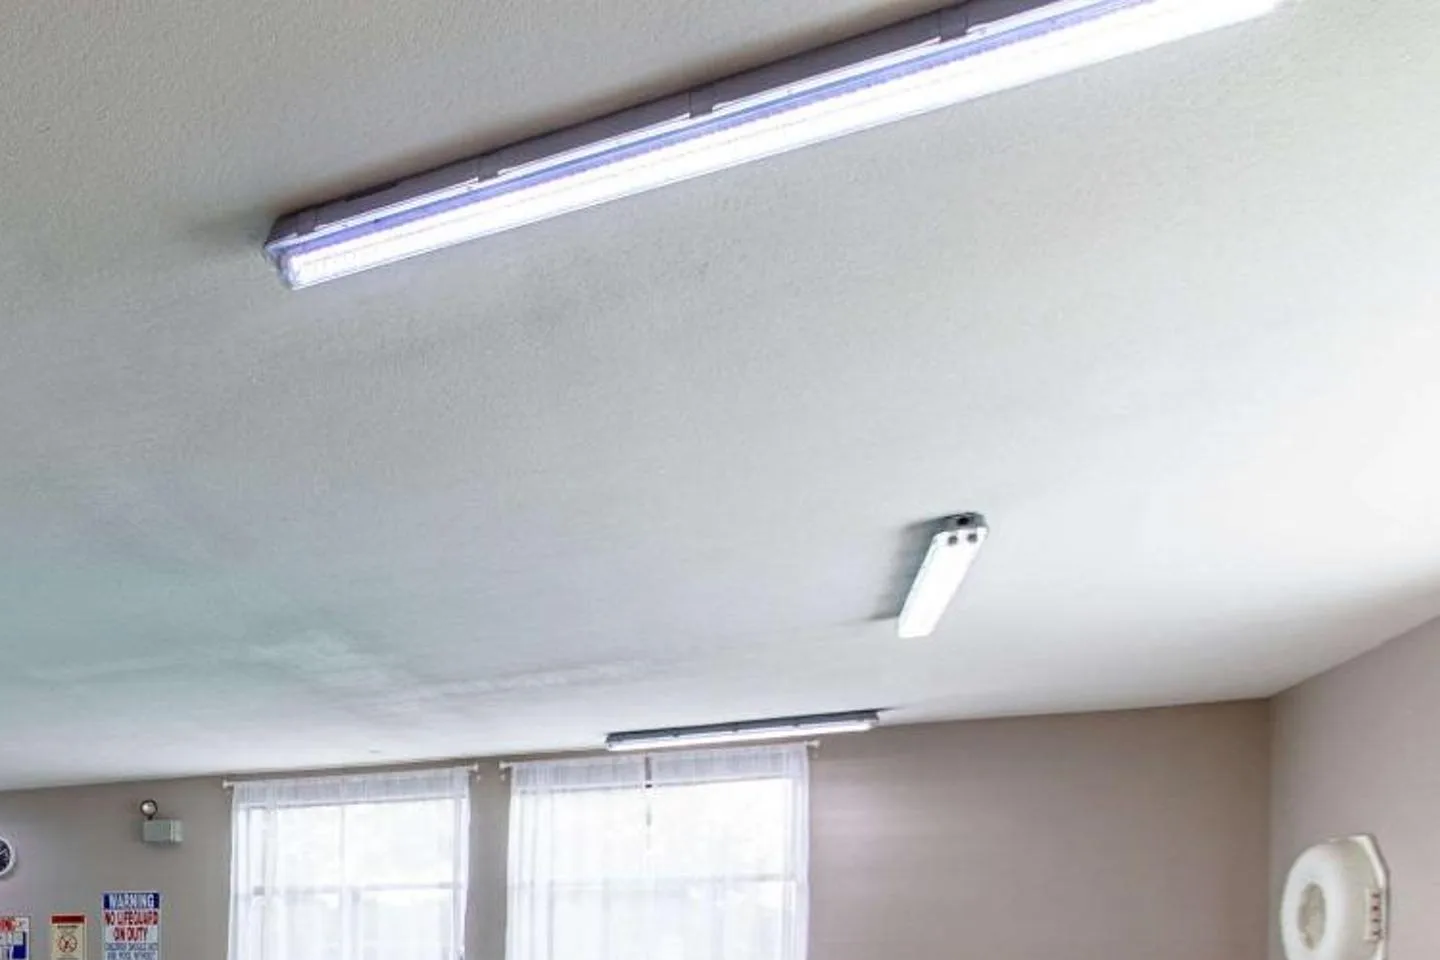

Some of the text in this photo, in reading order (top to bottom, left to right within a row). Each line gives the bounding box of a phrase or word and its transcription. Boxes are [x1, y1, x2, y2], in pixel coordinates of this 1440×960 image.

[108, 893, 155, 909] WARNING
[104, 910, 159, 926] NO LIFEGUARD
[113, 926, 148, 941] ON DUTY
